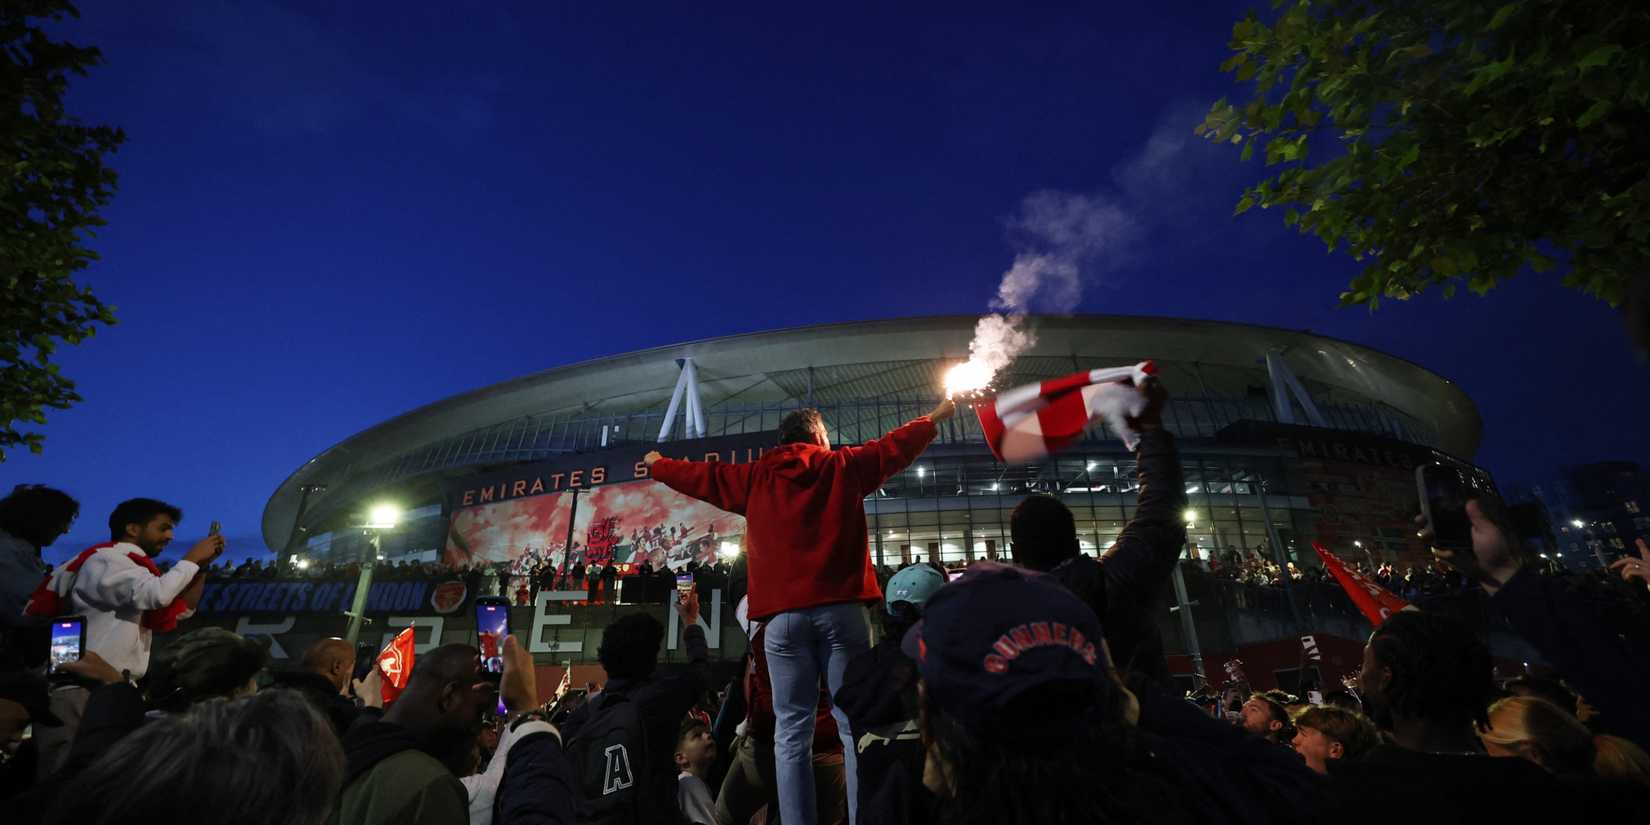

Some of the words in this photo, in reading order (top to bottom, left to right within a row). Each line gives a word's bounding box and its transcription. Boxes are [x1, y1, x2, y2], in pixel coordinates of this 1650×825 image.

[462, 467, 606, 505] EMIRATES
[214, 583, 310, 612] STREETS
[311, 582, 343, 611] OF
[340, 582, 427, 611] LNDON
[983, 621, 1098, 674] GUNNERS
[602, 743, 634, 796] A
